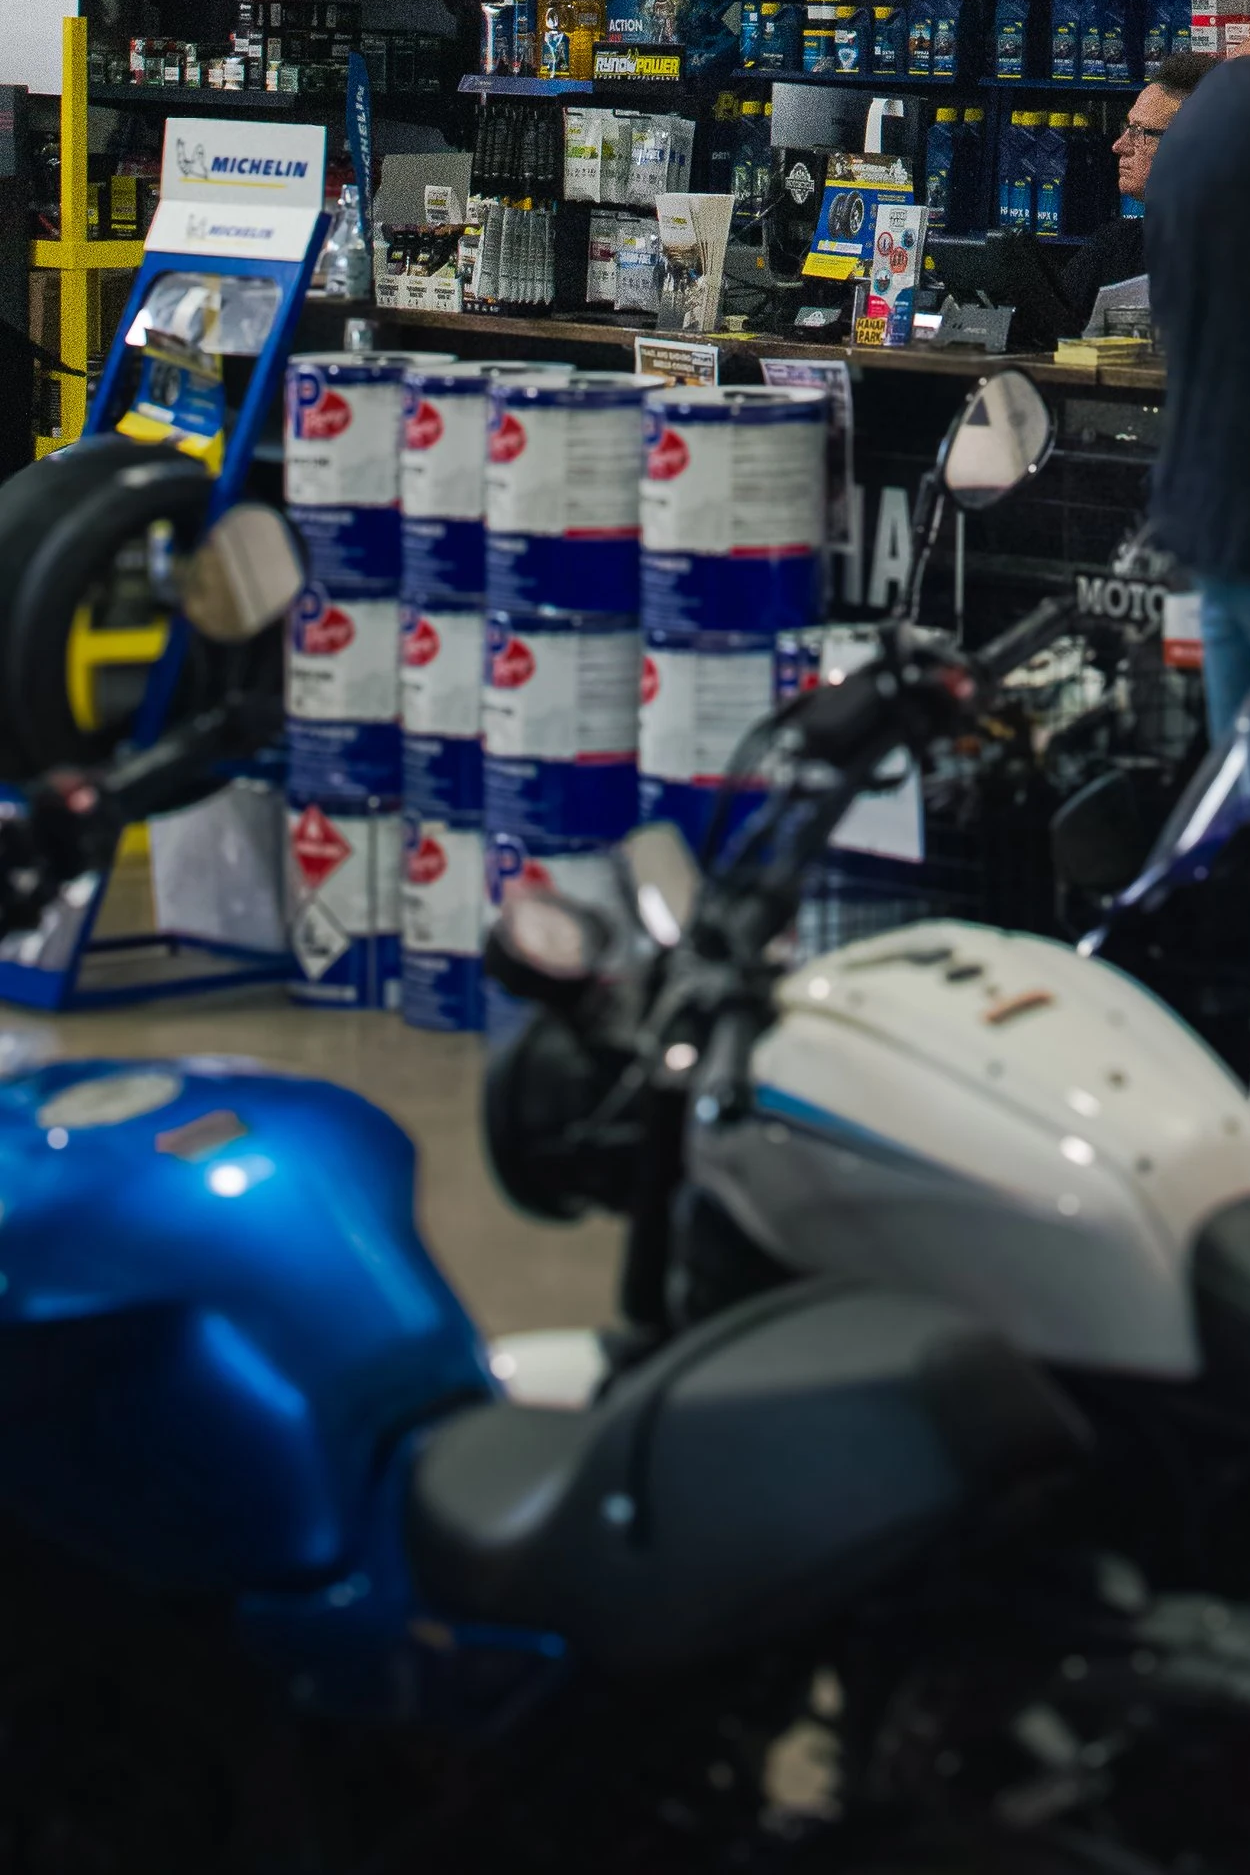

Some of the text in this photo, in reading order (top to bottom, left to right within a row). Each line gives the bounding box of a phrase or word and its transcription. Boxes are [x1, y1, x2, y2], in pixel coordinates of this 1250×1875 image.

[609, 19, 644, 32] ACTION
[635, 58, 680, 74] POWER
[210, 155, 310, 179] MICHELIN
[207, 224, 275, 240] MICHELIN
[856, 330, 884, 343] PARK
